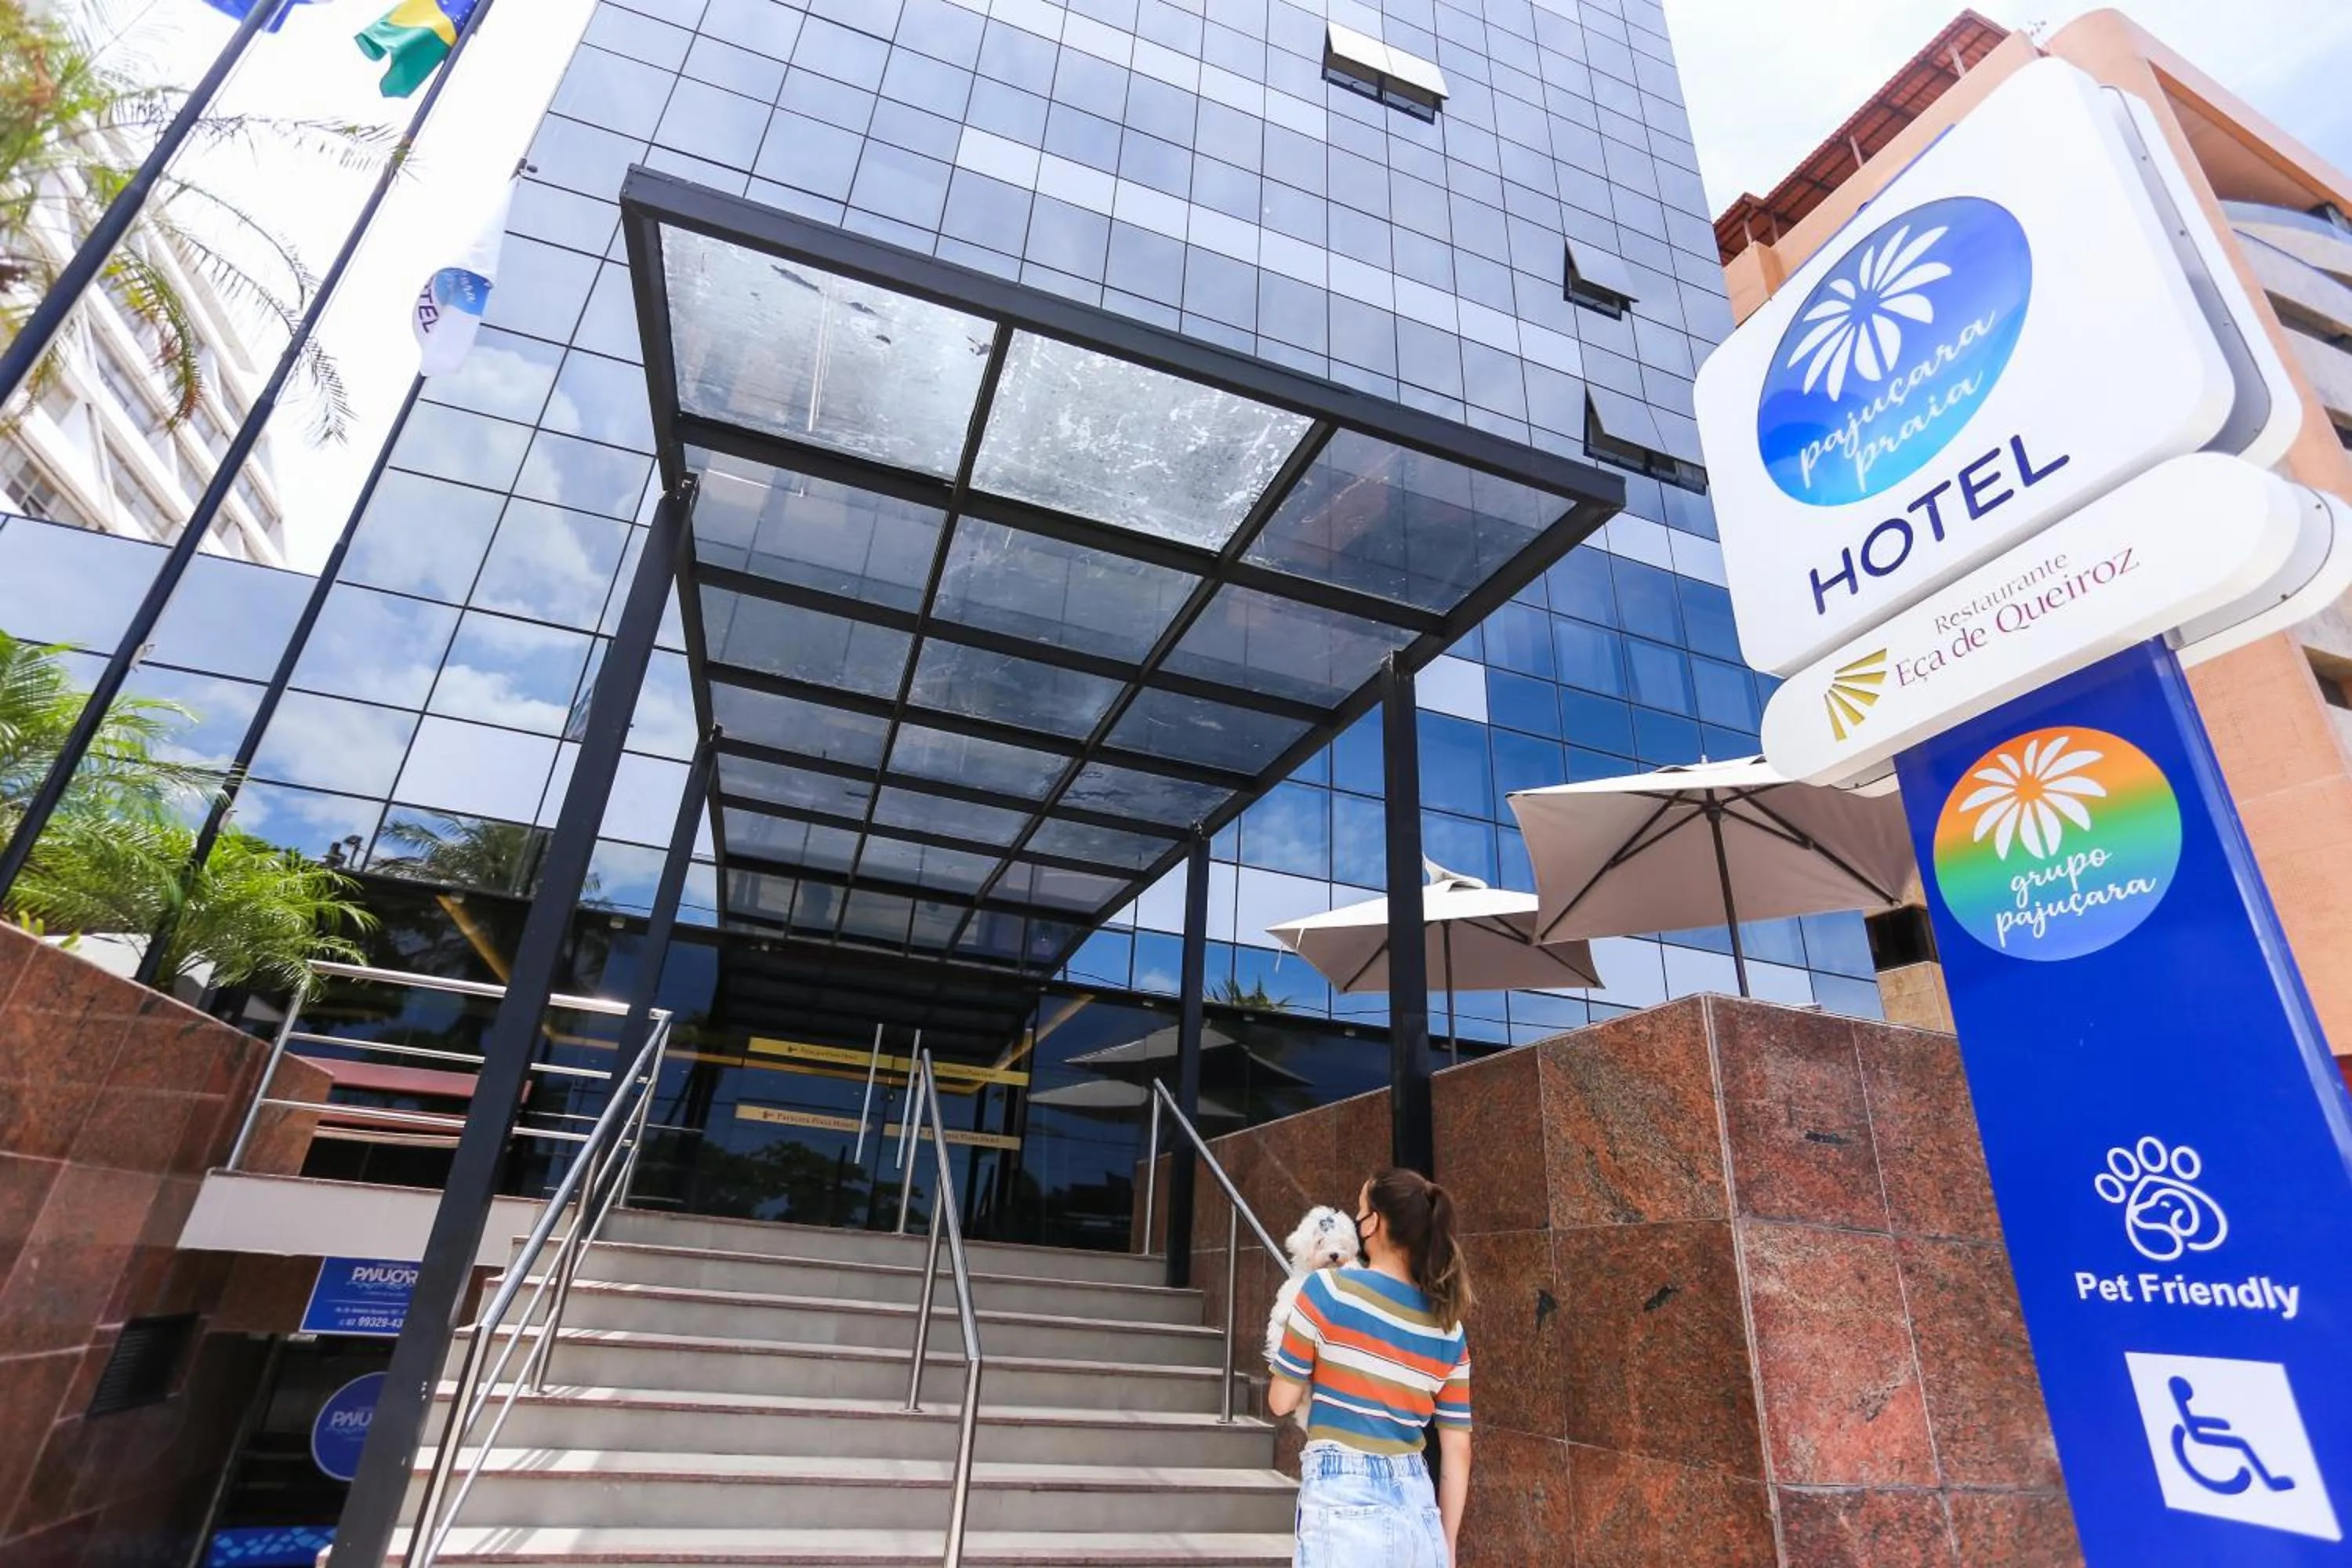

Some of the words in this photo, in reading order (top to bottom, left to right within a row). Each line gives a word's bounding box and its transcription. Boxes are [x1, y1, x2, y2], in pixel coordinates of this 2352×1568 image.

[1800, 309, 1996, 489] pajuçara
[1856, 369, 1984, 493] praia
[1809, 434, 2071, 615] HOTEL
[1895, 648, 1947, 687] Eça
[1951, 626, 1990, 659] de
[1995, 547, 2141, 633] Queiroz
[1933, 553, 2070, 635] Restaurante
[1995, 877, 2158, 949] pajuçara
[2010, 848, 2113, 907] grupo
[358, 1316, 404, 1329] 99329-43
[2075, 1272, 2133, 1302] Pet
[2138, 1272, 2299, 1319] Friendly
